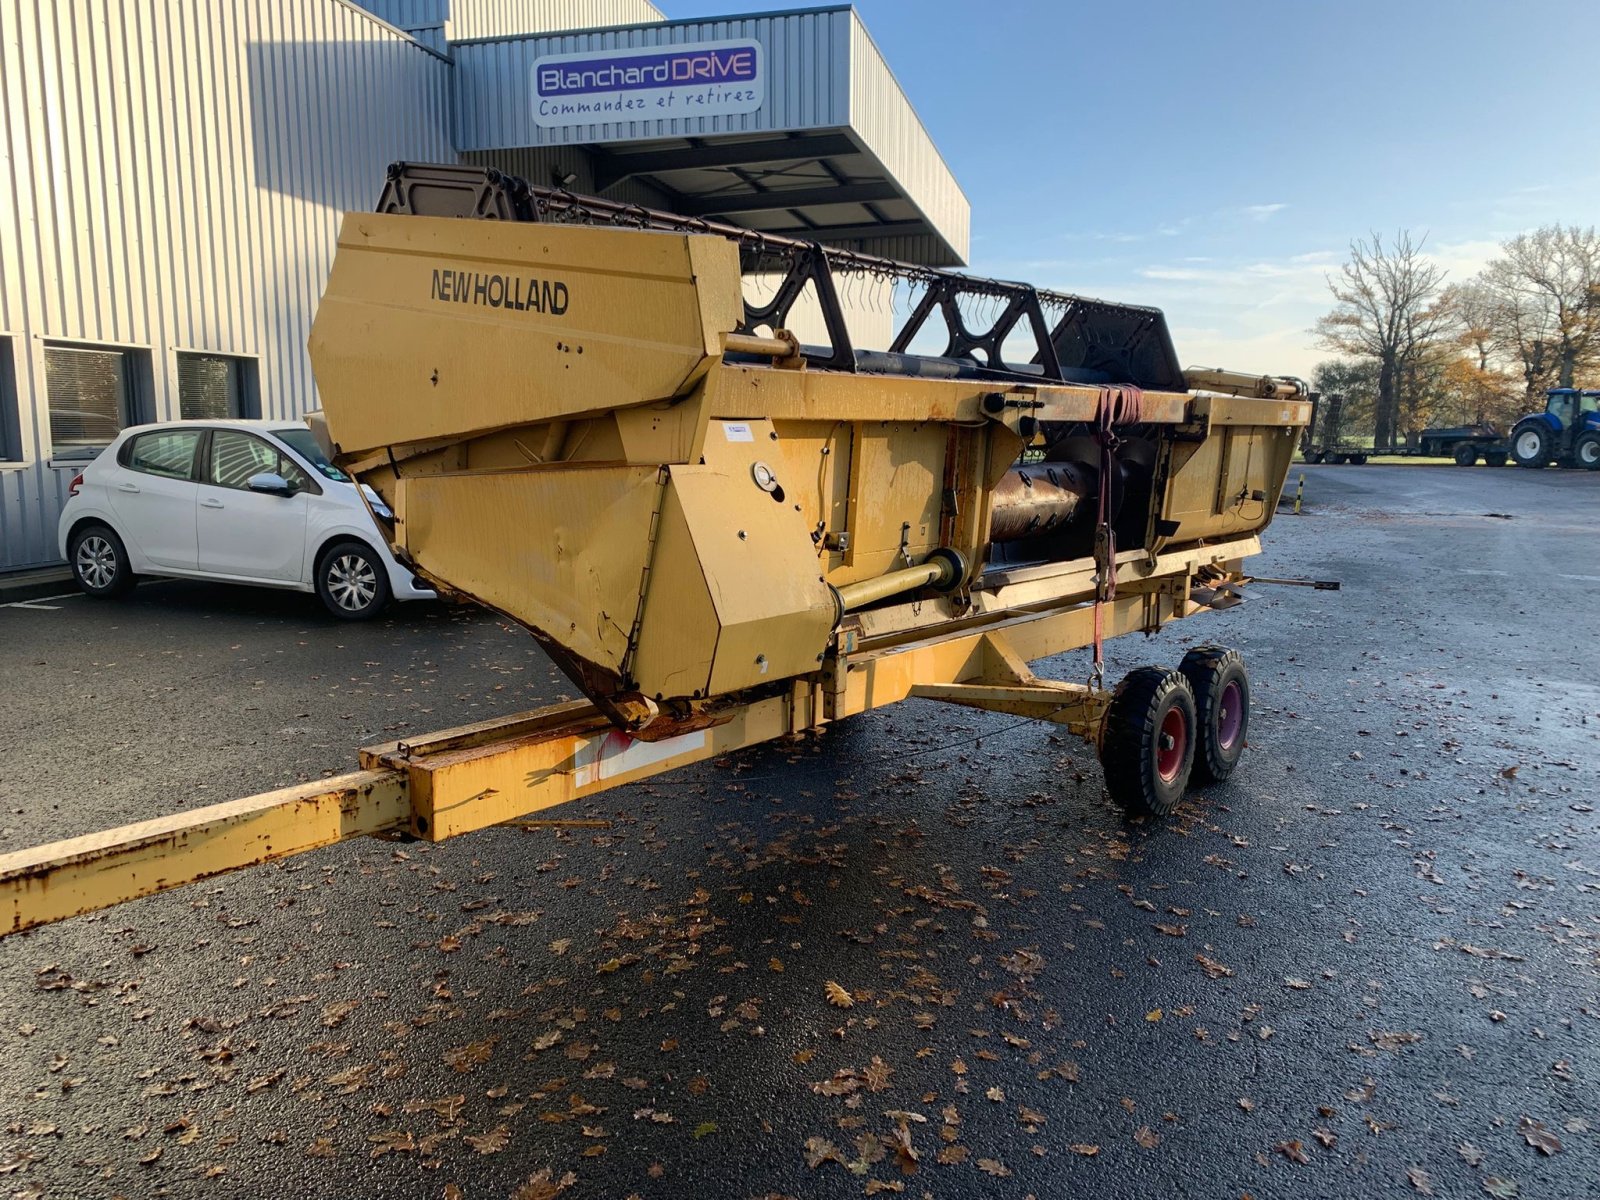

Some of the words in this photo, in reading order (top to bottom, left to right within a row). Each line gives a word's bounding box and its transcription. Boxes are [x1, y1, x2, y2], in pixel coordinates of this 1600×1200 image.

[541, 61, 668, 91] Blanchard
[539, 94, 646, 116] Commandez
[656, 91, 675, 107] et
[686, 85, 755, 105] retirez
[431, 269, 472, 303] NEW
[473, 273, 569, 316] HOLLAND
